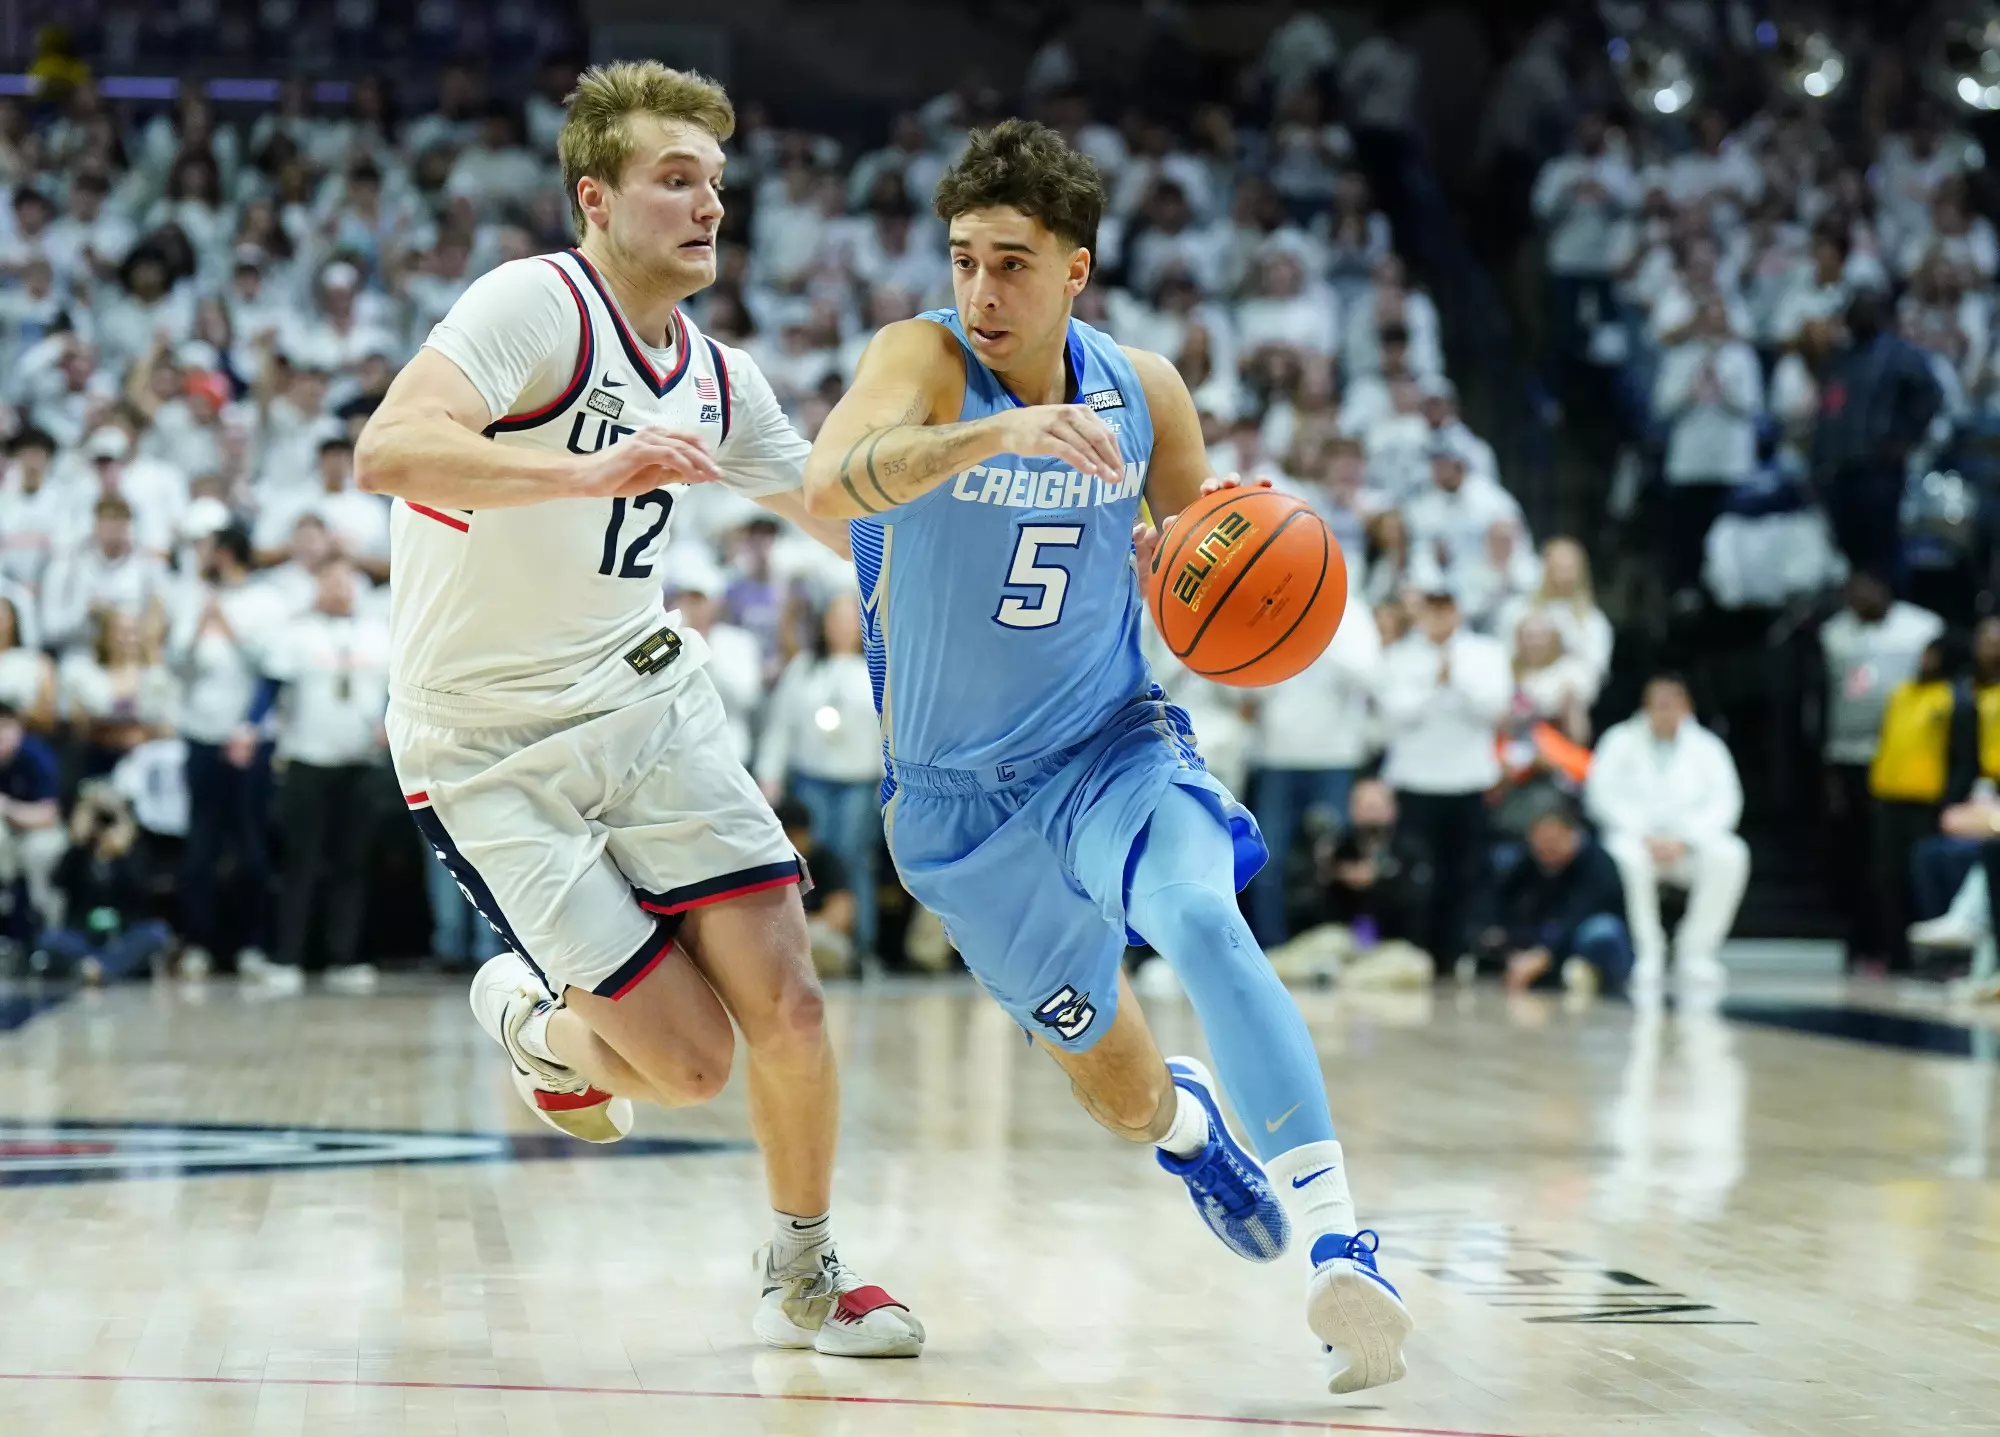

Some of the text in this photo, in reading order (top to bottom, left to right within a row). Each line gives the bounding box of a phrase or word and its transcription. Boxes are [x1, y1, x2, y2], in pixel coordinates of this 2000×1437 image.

[588, 398, 619, 417] CHANGE
[701, 404, 717, 412] BIG
[1088, 398, 1122, 410] CHANGE
[700, 412, 721, 420] EAST
[884, 457, 908, 476] 555
[952, 461, 1145, 509] CREIGHTON
[598, 488, 674, 579] 12
[1171, 511, 1253, 607] ELITE
[991, 523, 1085, 630] 5
